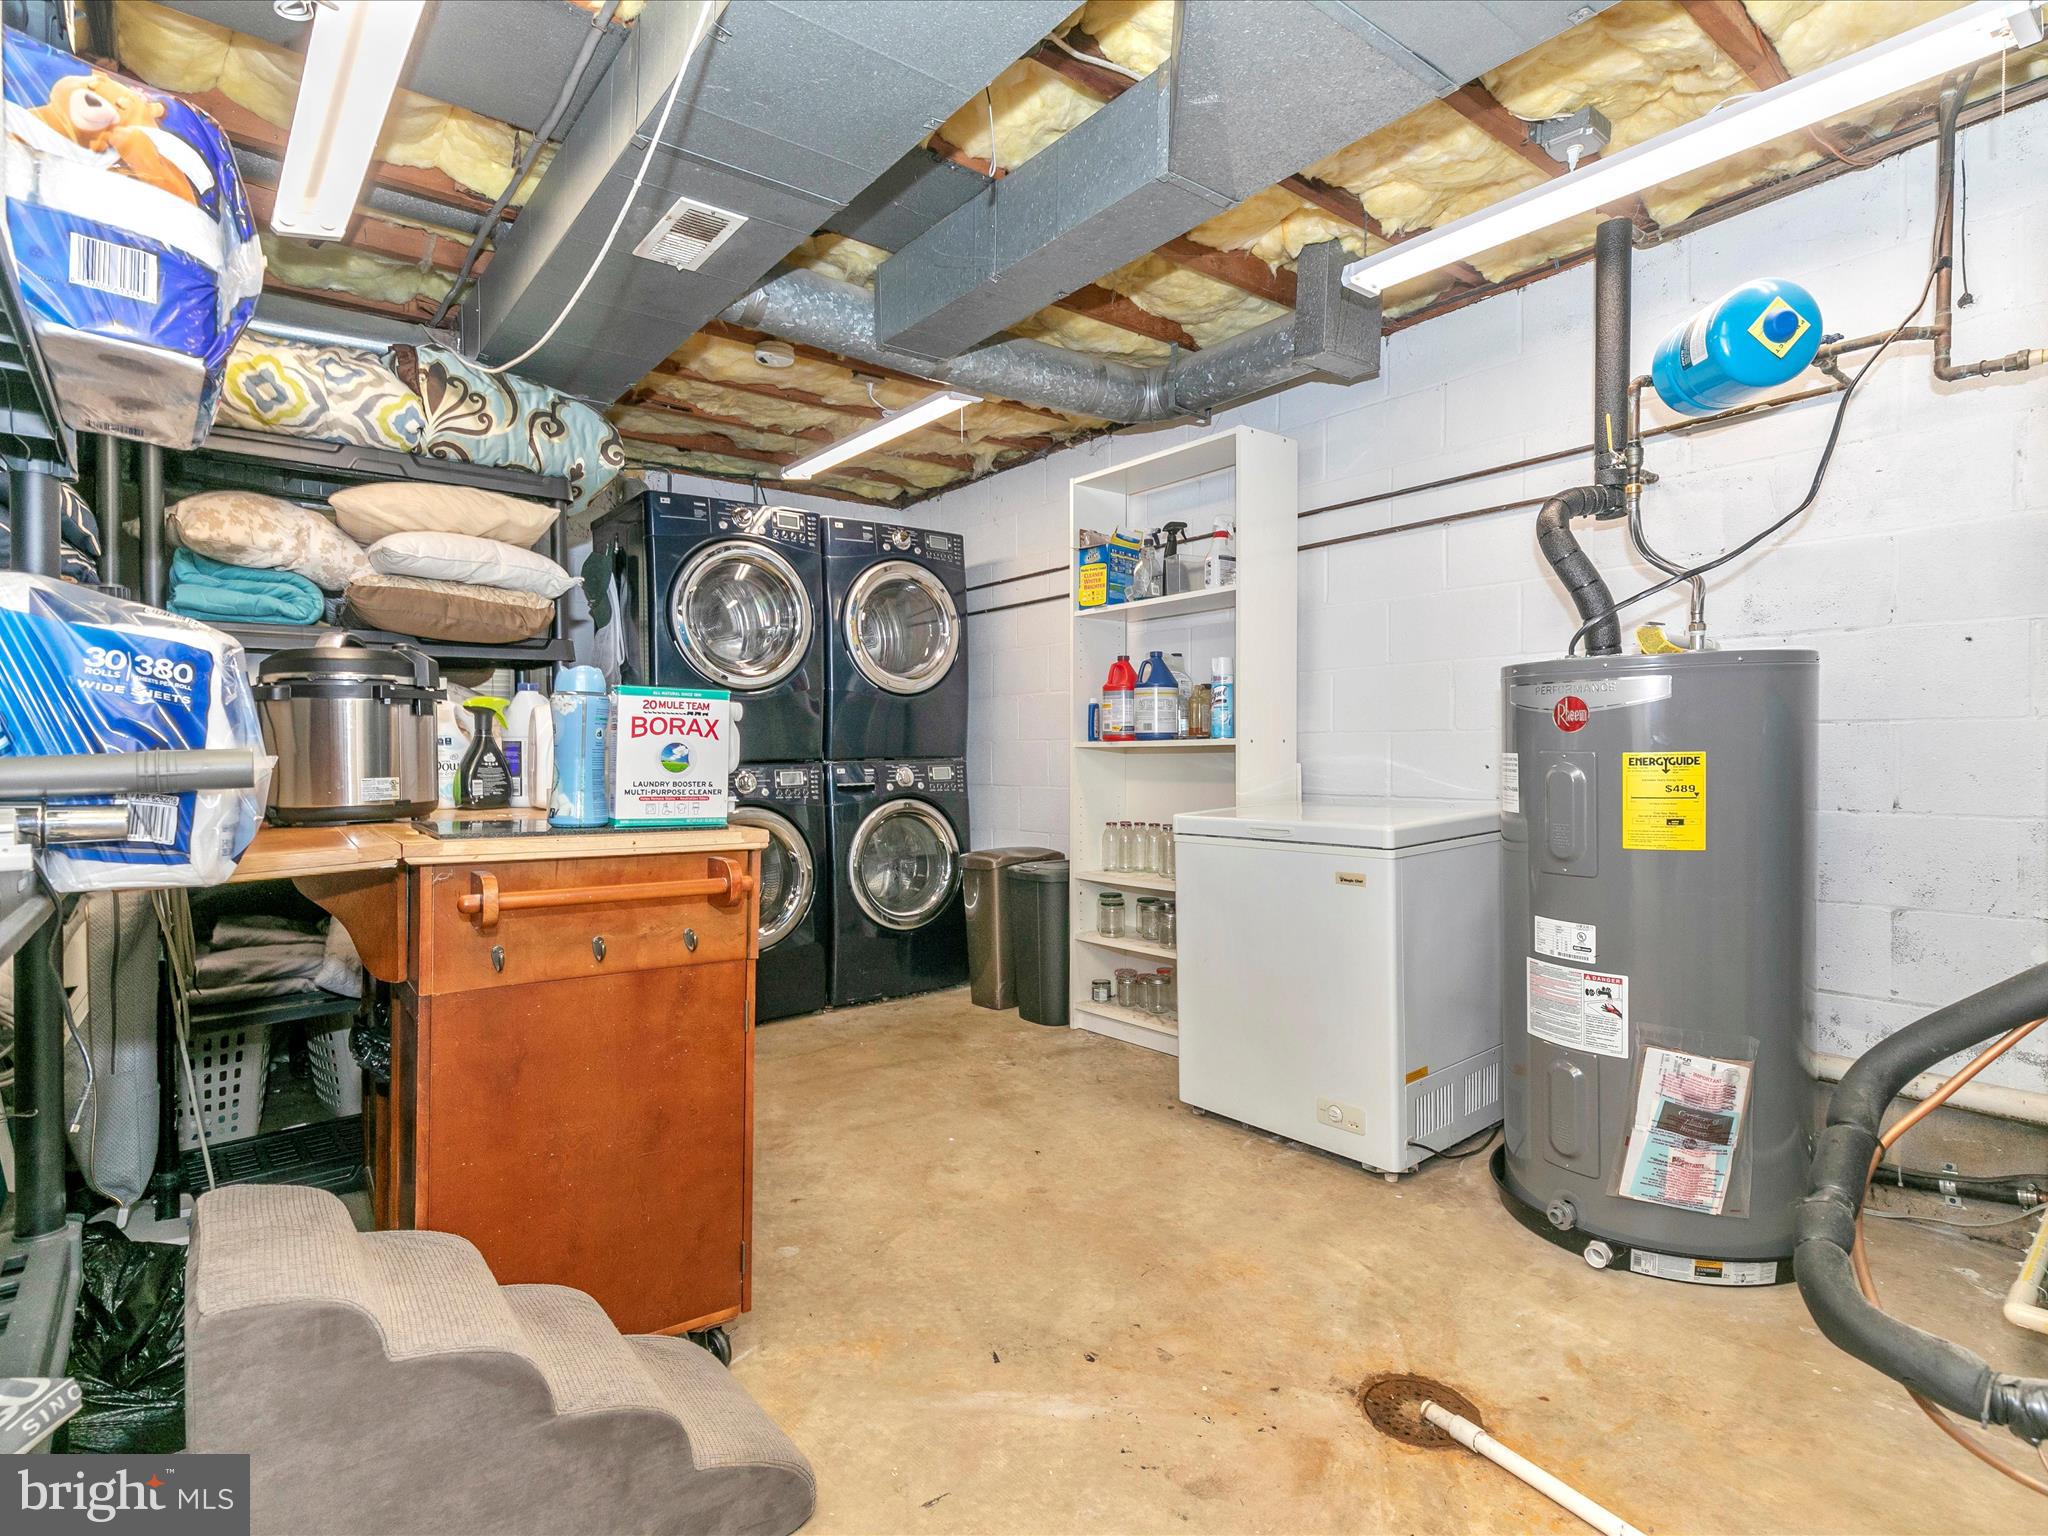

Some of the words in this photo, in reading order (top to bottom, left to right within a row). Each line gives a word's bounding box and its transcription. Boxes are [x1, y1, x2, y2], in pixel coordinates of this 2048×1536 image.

[83, 646, 127, 670] 30
[84, 667, 121, 679] ROLLS
[134, 655, 193, 684] 380
[77, 679, 126, 694] WIDE
[130, 688, 192, 705] SHEETS
[174, 682, 193, 692] ROLL
[1535, 681, 1616, 696] PERFORMANCE
[642, 699, 658, 710] 20
[658, 700, 685, 710] MULE
[686, 701, 710, 711] TEAM
[1557, 697, 1587, 727] Rheem
[631, 716, 720, 741] BORAX
[1628, 756, 1701, 767] ENERGYGUIDE
[1665, 784, 1696, 793] $489
[1592, 975, 1622, 984] DANGER
